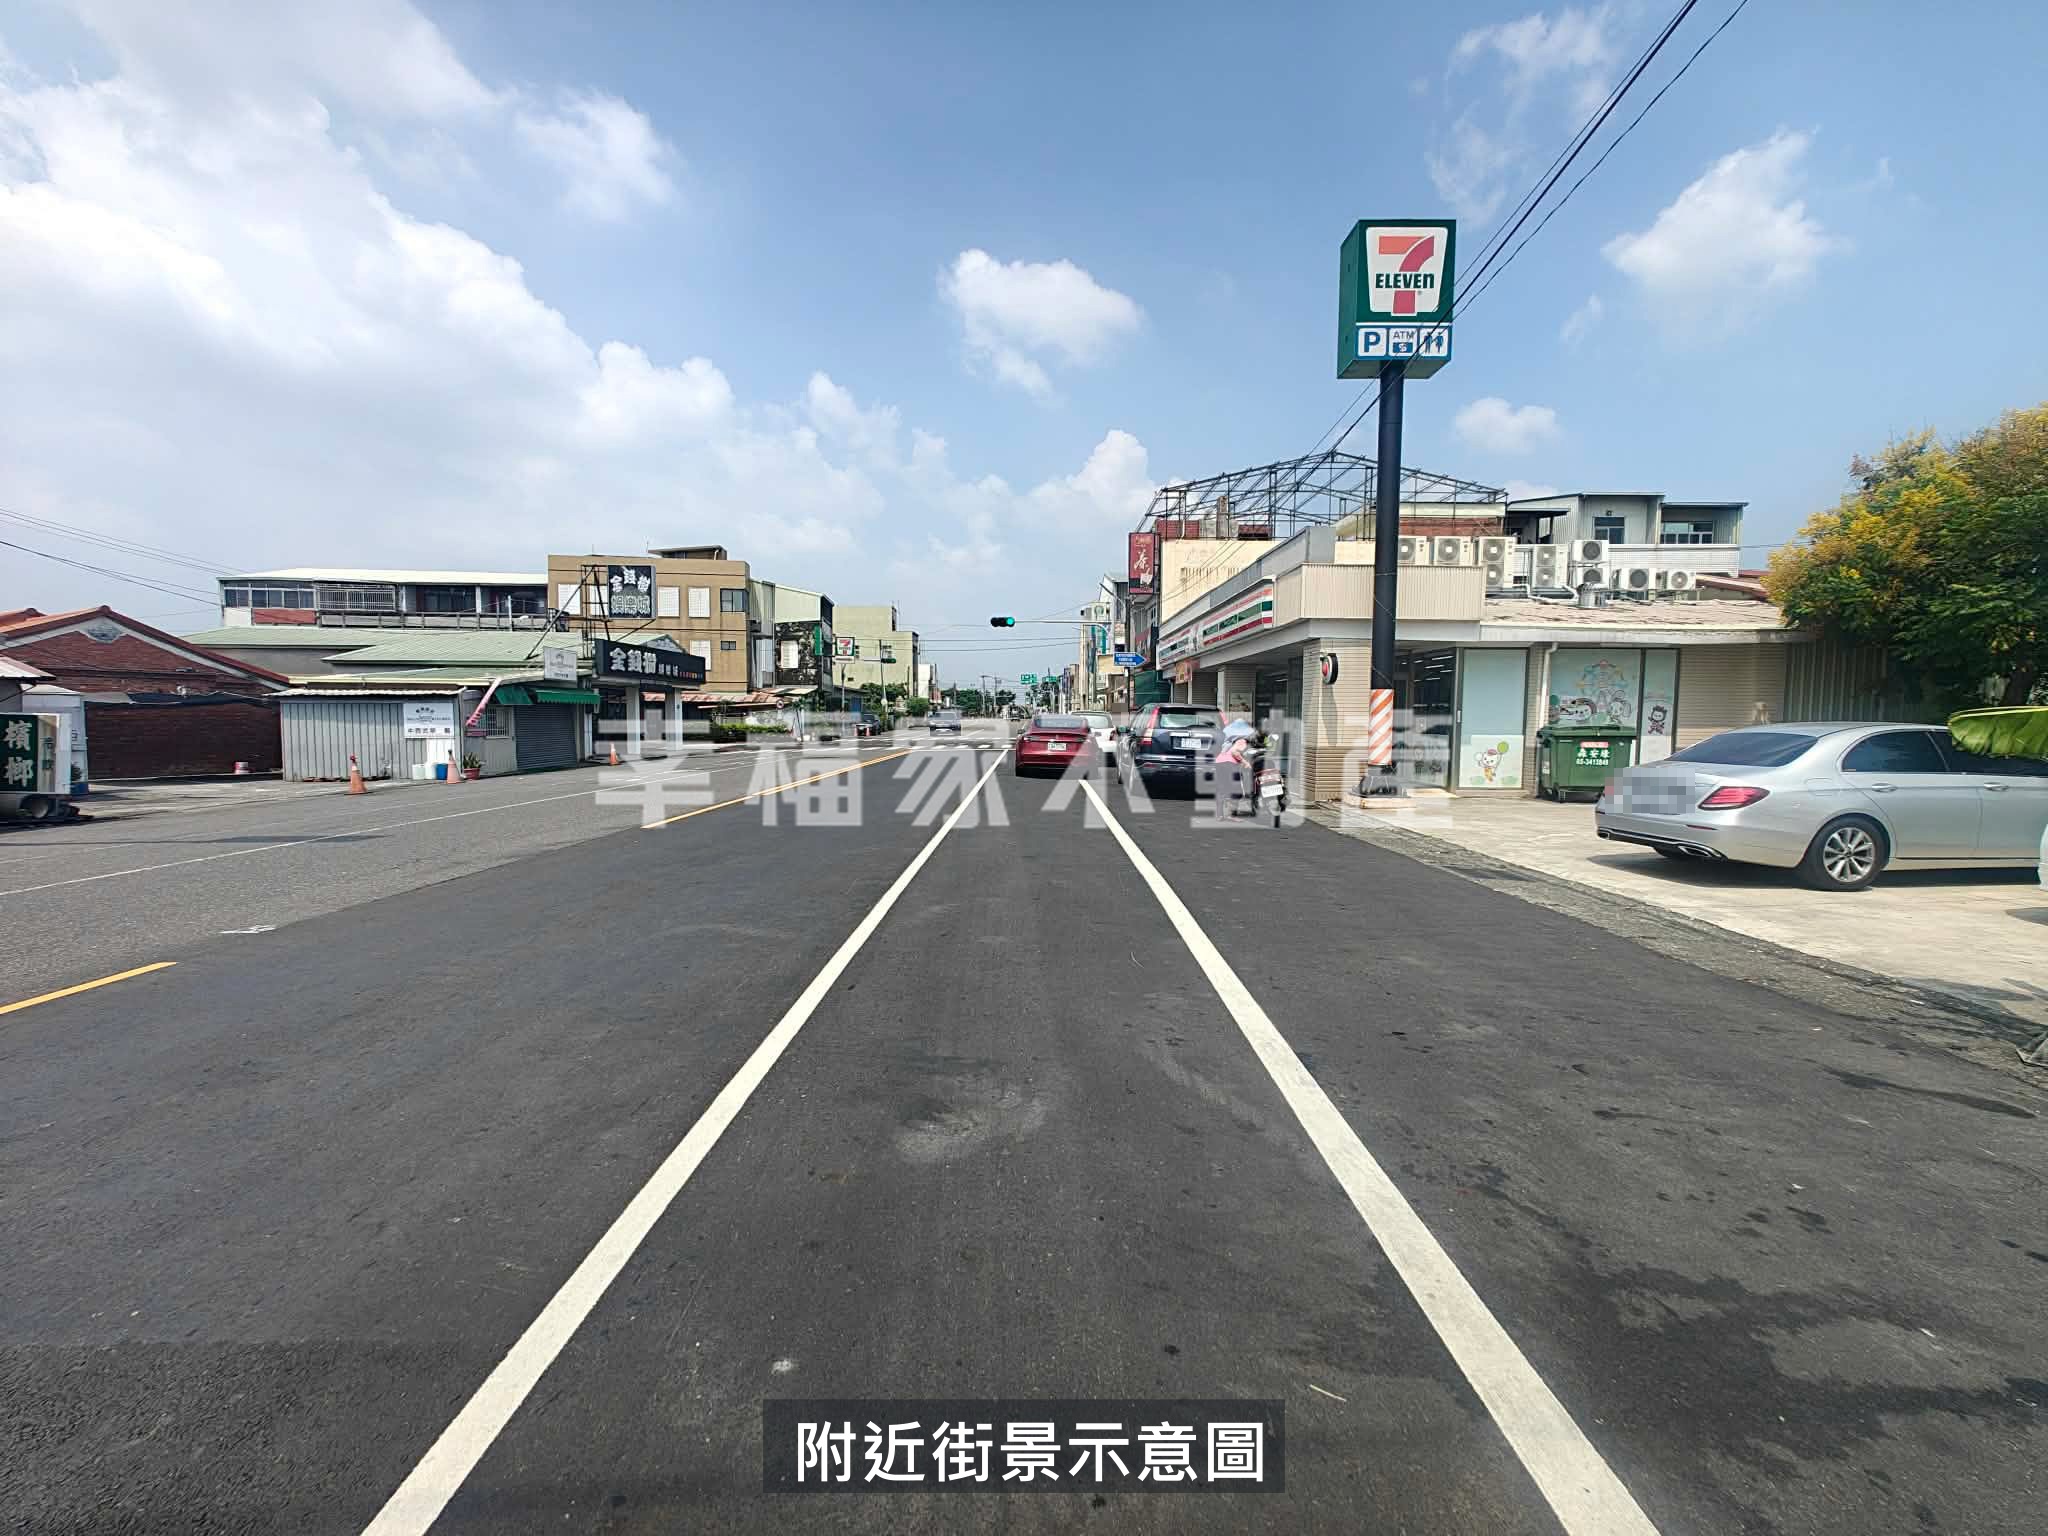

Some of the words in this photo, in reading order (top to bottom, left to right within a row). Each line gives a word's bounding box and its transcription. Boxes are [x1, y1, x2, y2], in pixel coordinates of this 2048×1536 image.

[1375, 273, 1435, 289] ELEVEN
[1363, 332, 1381, 353] P
[1392, 330, 1415, 340] ATM
[3, 720, 35, 788] 檳榔
